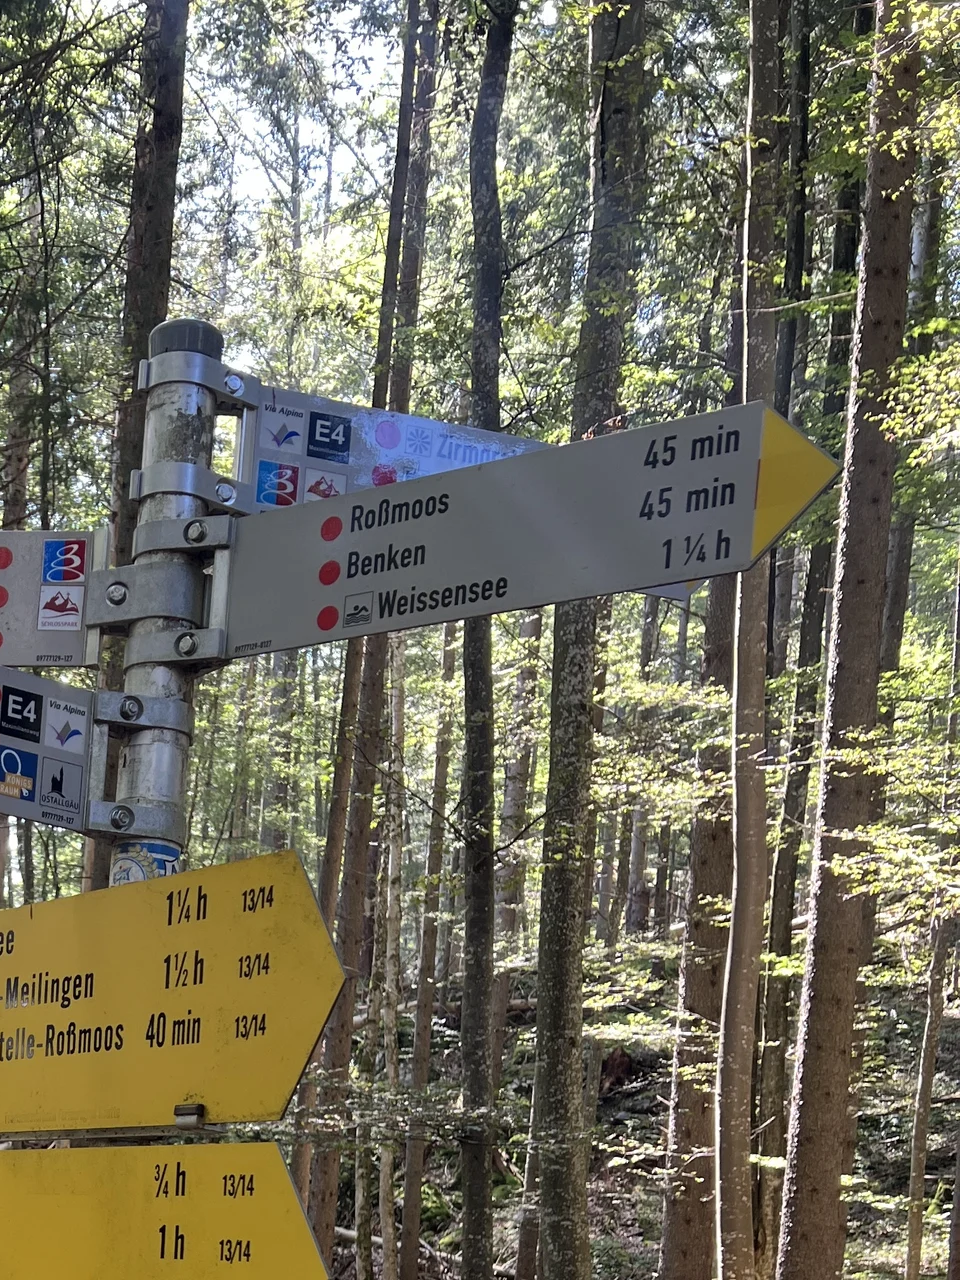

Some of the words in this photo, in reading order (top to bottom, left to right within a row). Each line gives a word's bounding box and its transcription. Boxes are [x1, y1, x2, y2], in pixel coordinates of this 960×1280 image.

[264, 404, 277, 413] Via
[280, 407, 304, 419] Alpina
[315, 419, 345, 445] E4
[349, 493, 450, 533] Roßmoos
[643, 434, 677, 469] 45
[690, 424, 740, 461] min
[346, 544, 426, 579] Benken
[639, 487, 672, 521] 45
[685, 477, 735, 513] min
[377, 576, 508, 619] Weissensee
[715, 530, 731, 559] h
[7, 694, 37, 723] E4
[49, 700, 61, 710] Via
[63, 704, 86, 717] Alpina
[41, 794, 79, 810] OSTALLGÄU
[165, 889, 193, 926] 1¼
[196, 885, 208, 920] h
[242, 884, 274, 914] 13/14
[163, 954, 190, 990] 1½
[193, 950, 205, 985] h
[238, 952, 270, 979] 13/14
[145, 1013, 166, 1049] 40
[172, 1010, 201, 1046] min
[234, 1014, 267, 1040] 13/14
[154, 1163, 169, 1198] ¾
[175, 1161, 186, 1196] h
[222, 1173, 255, 1197] 13/14
[158, 1225, 166, 1259] 1
[174, 1225, 185, 1260] h
[219, 1239, 251, 1263] 13/14
